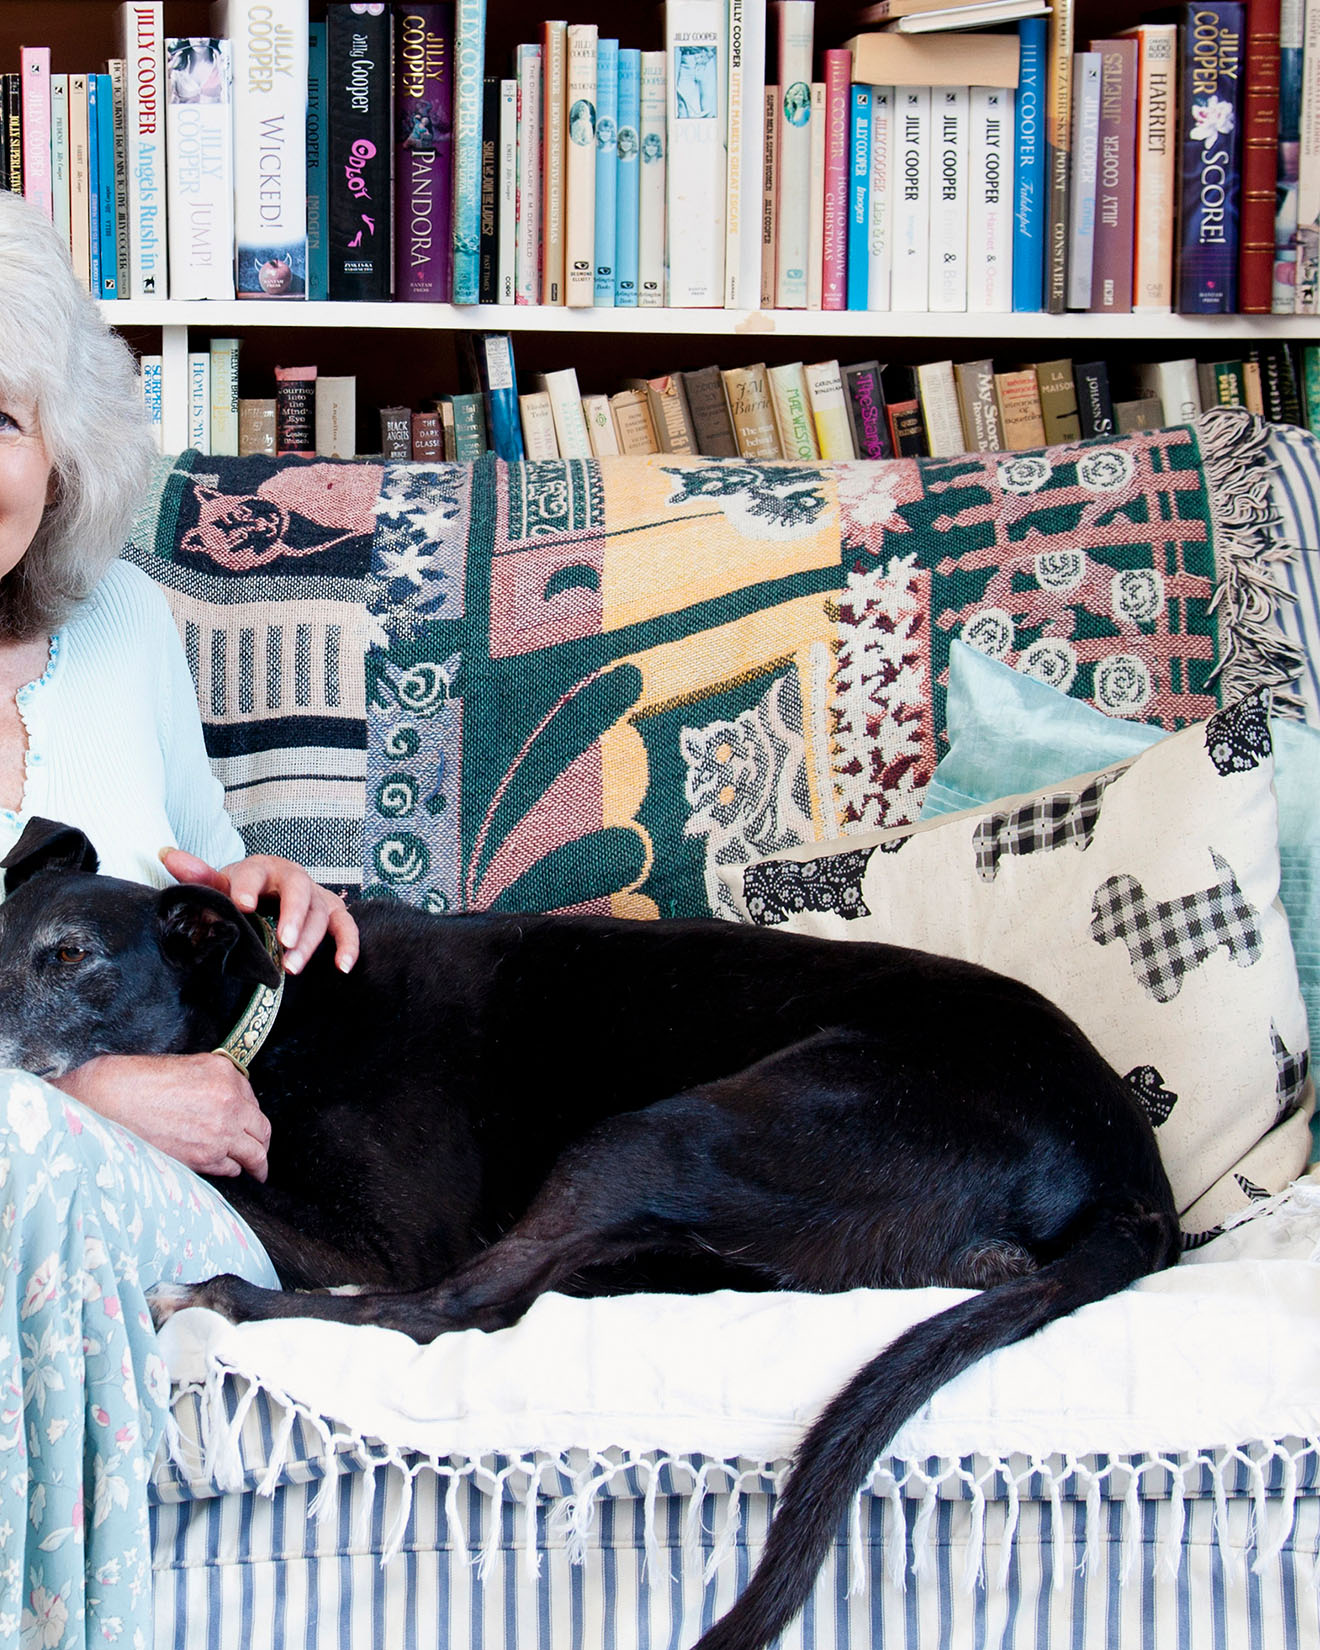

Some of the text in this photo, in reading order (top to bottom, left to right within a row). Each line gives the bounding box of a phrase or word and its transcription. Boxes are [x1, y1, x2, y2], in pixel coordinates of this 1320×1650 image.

[247, 7, 273, 94] COOPER
[276, 24, 294, 78] JILLY
[345, 33, 375, 113] Jilly Cooper
[403, 15, 426, 98] COOPER
[426, 32, 445, 83] JILLY
[674, 32, 717, 41] JILLY COOPER
[1021, 44, 1037, 86] JILLY
[1192, 11, 1219, 94] COOPER
[1220, 29, 1239, 79] JILLY
[29, 91, 43, 176] JILLY COOPER
[134, 8, 158, 271] JILLY COOPER Angels Rush in
[831, 60, 845, 158] JILLY COOPER
[906, 115, 920, 145] JILLY
[1020, 92, 1036, 167] COOPER
[1102, 52, 1122, 227] JINETES JILLY COOPER
[1149, 73, 1167, 155] HARRIET
[177, 109, 201, 195] COOPER
[201, 126, 222, 180] JILLY
[259, 113, 285, 229] WICKED!
[309, 76, 320, 249] JILLY COOPER IMOGEN
[855, 117, 868, 224] JILLY COOPER Imogen
[905, 150, 919, 200] COOPER
[1078, 96, 1098, 235] JILLY COOPER Emily
[189, 202, 214, 267] JUMP!
[410, 150, 436, 267] PANDORA
[824, 193, 834, 261] CHRISTMAS
[836, 176, 847, 278] HOW TO SURVIVE
[1199, 151, 1229, 244] SCORE!
[152, 365, 162, 424] SURPRISE
[1051, 372, 1064, 381] LA
[287, 415, 305, 423] Eye
[386, 421, 408, 431] BLACK
[387, 431, 410, 441] ANGUS
[422, 419, 437, 428] THE
[787, 388, 809, 446] MAE WEST
